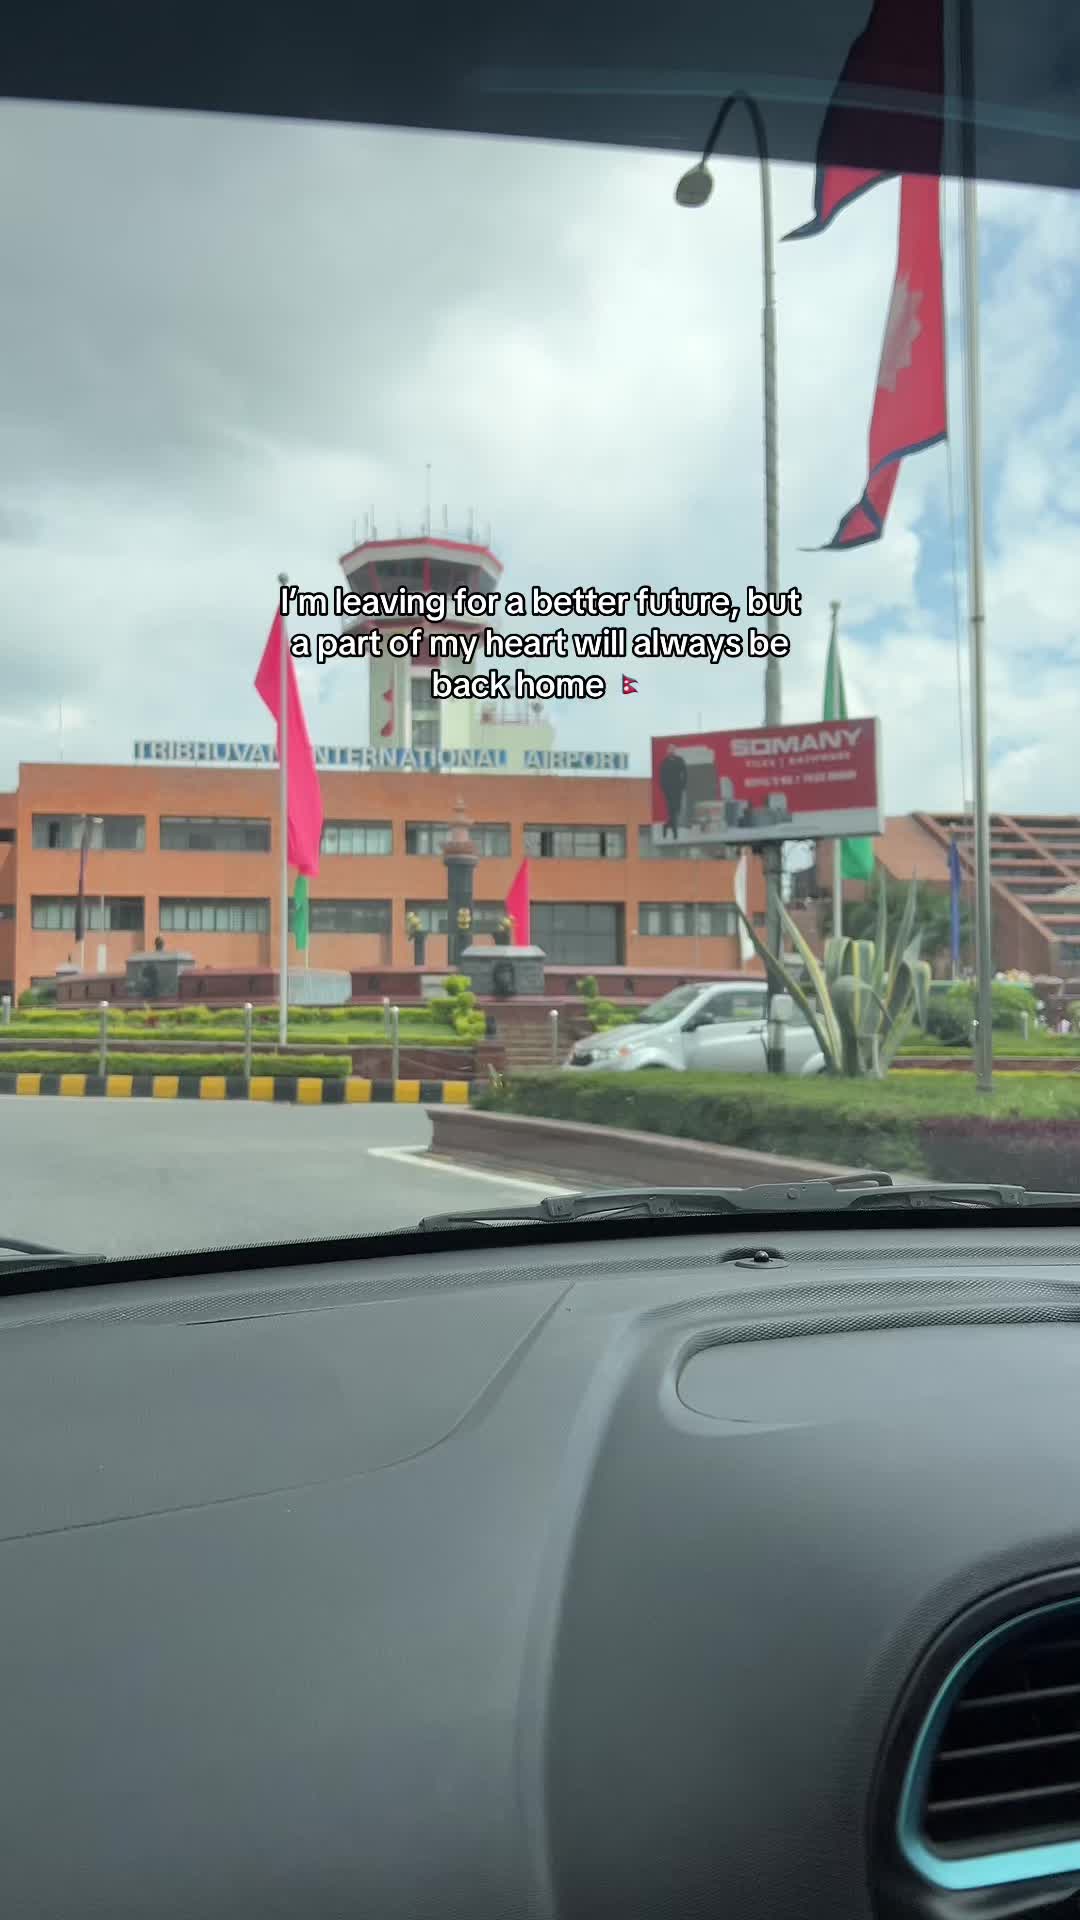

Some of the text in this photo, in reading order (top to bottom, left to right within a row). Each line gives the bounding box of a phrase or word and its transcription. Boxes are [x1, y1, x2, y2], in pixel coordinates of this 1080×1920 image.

[730, 728, 862, 757] SOMANY
[308, 745, 508, 769] NTERNATIONAL
[524, 751, 629, 770] AIRPORT
